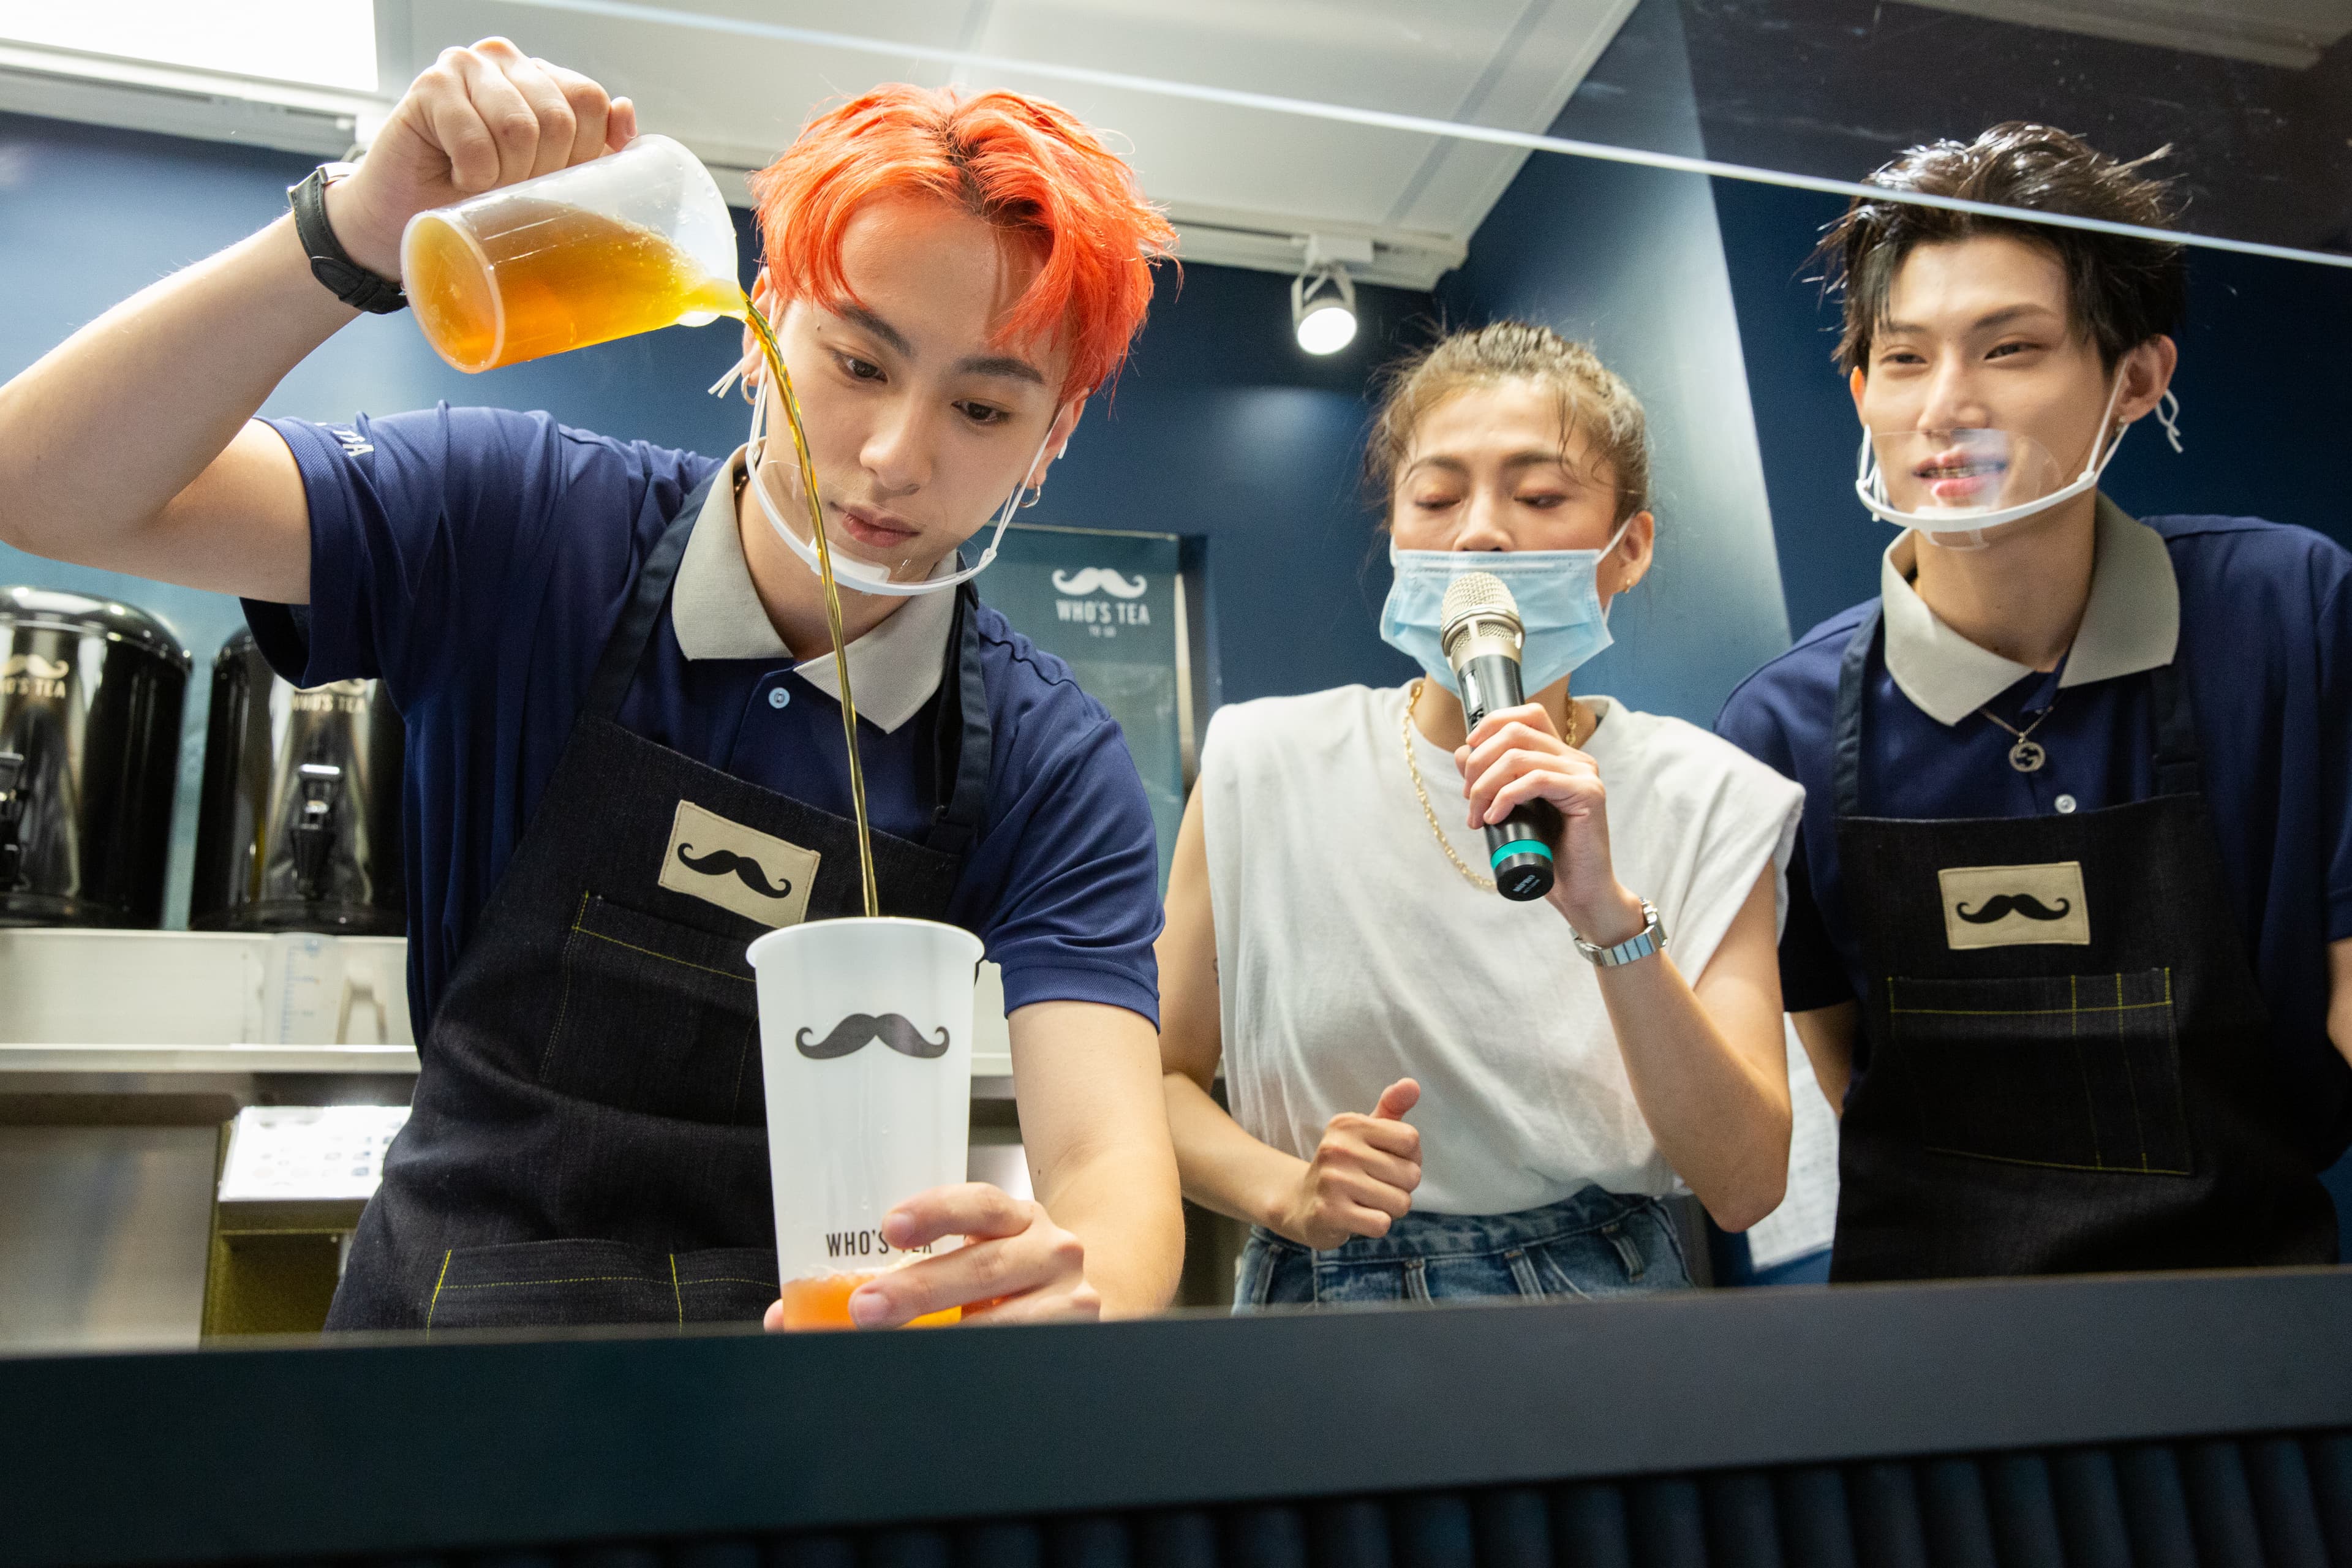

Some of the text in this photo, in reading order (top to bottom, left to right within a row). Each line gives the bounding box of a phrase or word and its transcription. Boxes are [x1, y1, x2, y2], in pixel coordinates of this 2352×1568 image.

[1055, 598, 1151, 625] WHO'S TEA
[34, 677, 66, 698] TEA
[826, 1229, 889, 1257] WHO'S
